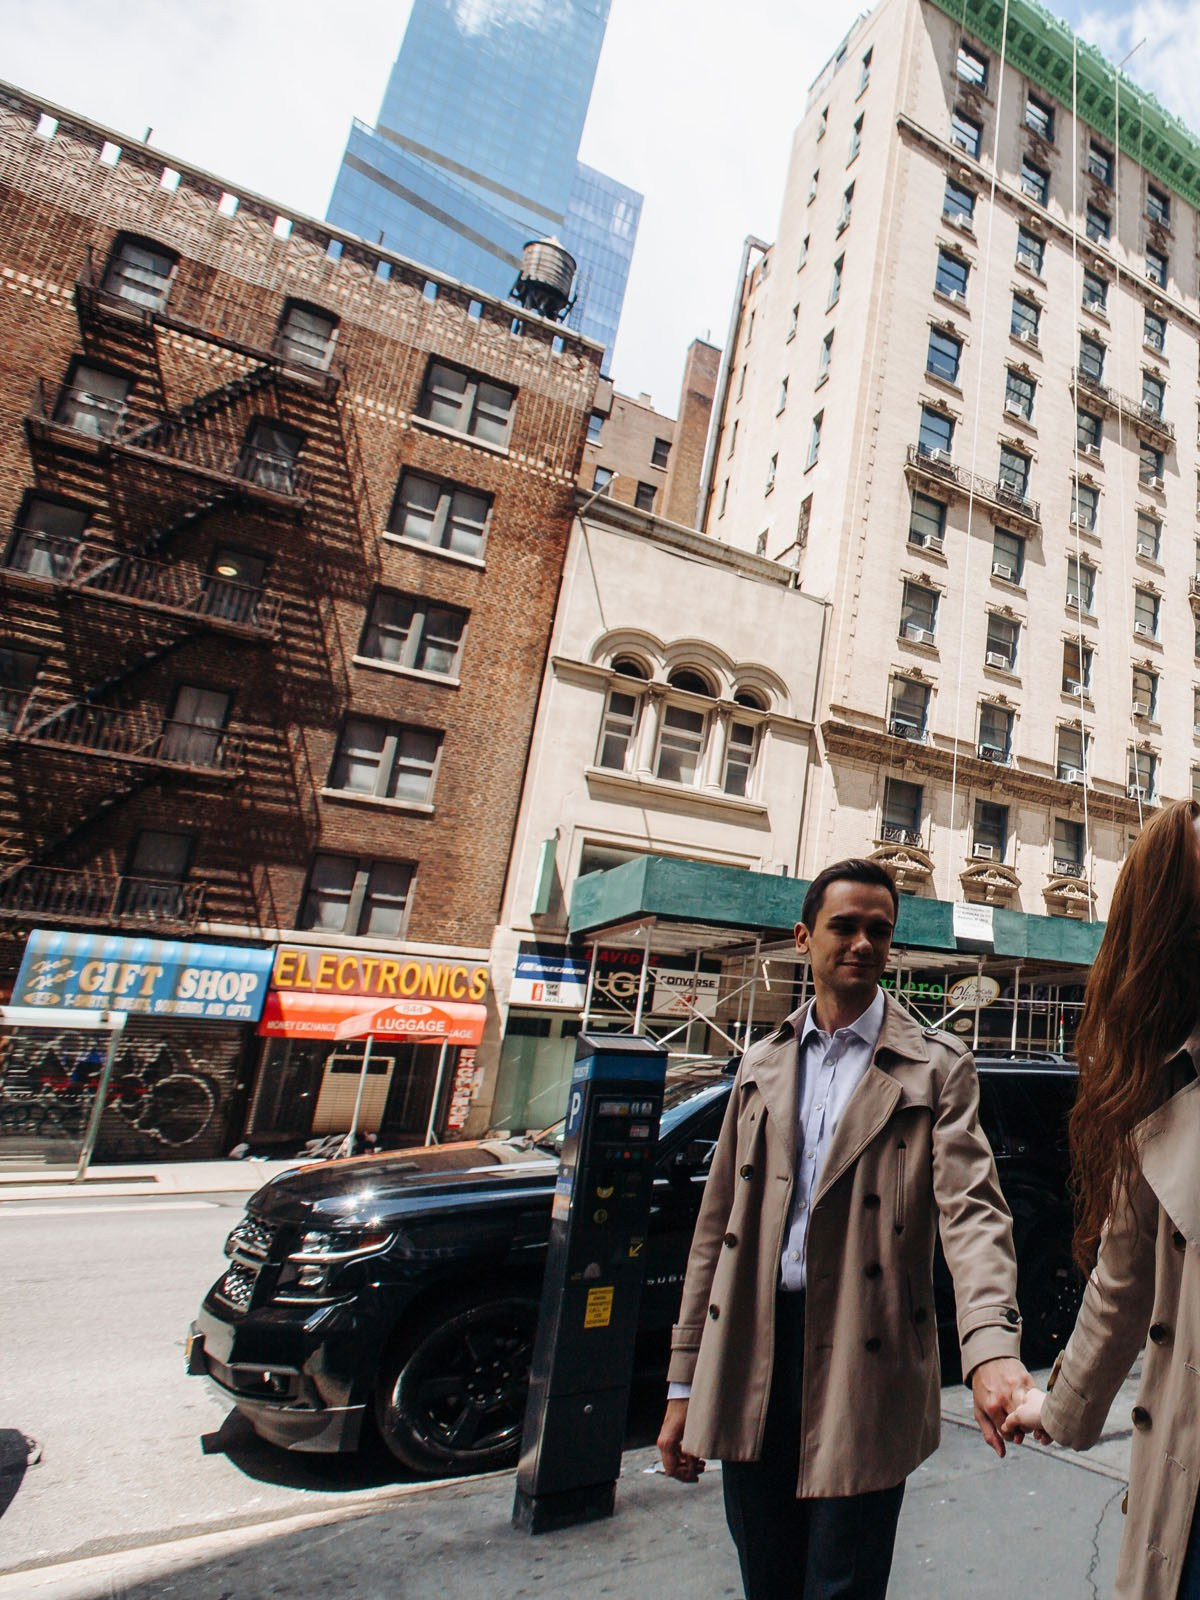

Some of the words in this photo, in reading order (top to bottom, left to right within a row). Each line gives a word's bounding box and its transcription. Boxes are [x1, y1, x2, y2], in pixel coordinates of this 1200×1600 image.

[584, 948, 640, 965] DAVID
[79, 961, 163, 996] GIFT
[176, 968, 258, 1002] SHOP
[274, 950, 488, 1000] ELECTRONICS
[660, 975, 716, 988] CONVERSE
[880, 978, 943, 1000] vero
[376, 1017, 446, 1032] LUGGAGE
[569, 1091, 581, 1130] P
